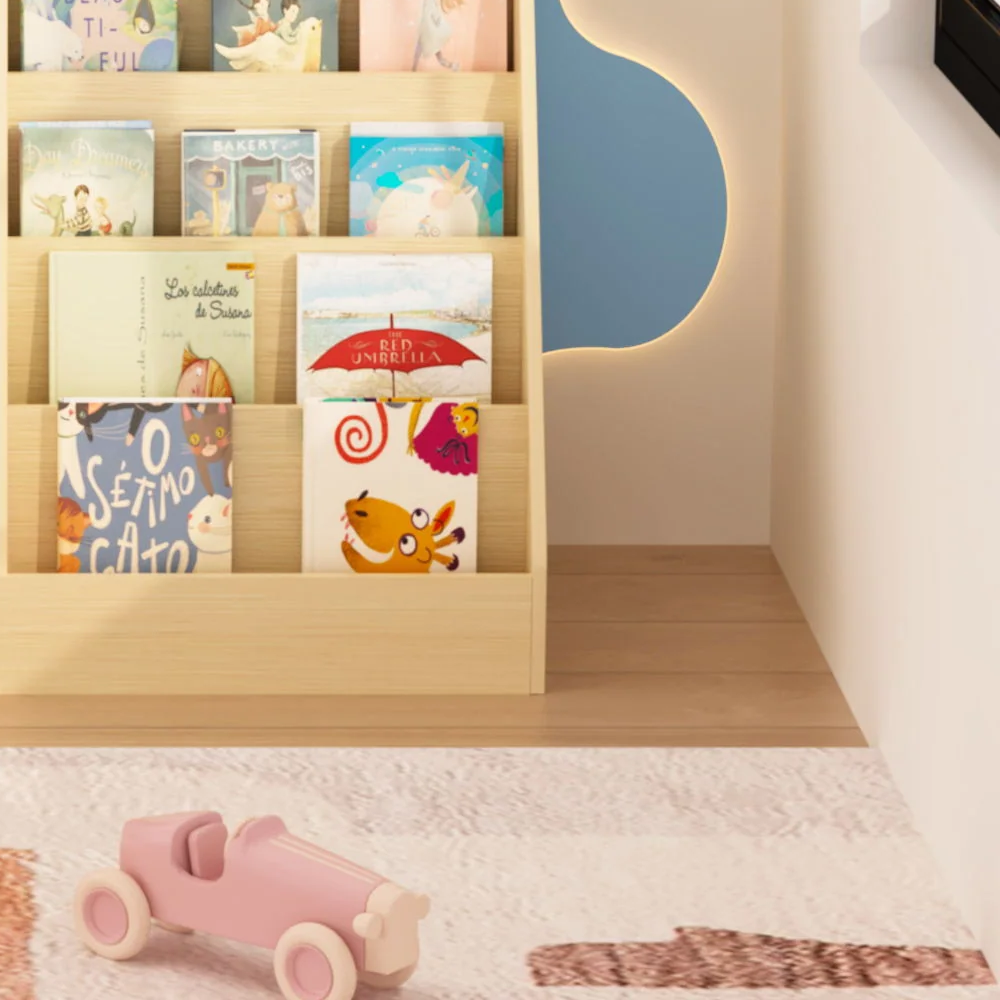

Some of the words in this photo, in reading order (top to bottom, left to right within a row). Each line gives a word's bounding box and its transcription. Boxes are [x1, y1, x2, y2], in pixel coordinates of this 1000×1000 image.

[83, 17, 118, 38] TI-
[213, 139, 279, 153] BAKERY
[164, 277, 190, 300] Los
[195, 301, 207, 319] de
[209, 299, 252, 320] Susana
[379, 338, 413, 352] RED
[351, 351, 443, 367] UMBRELLA
[141, 418, 171, 476] O
